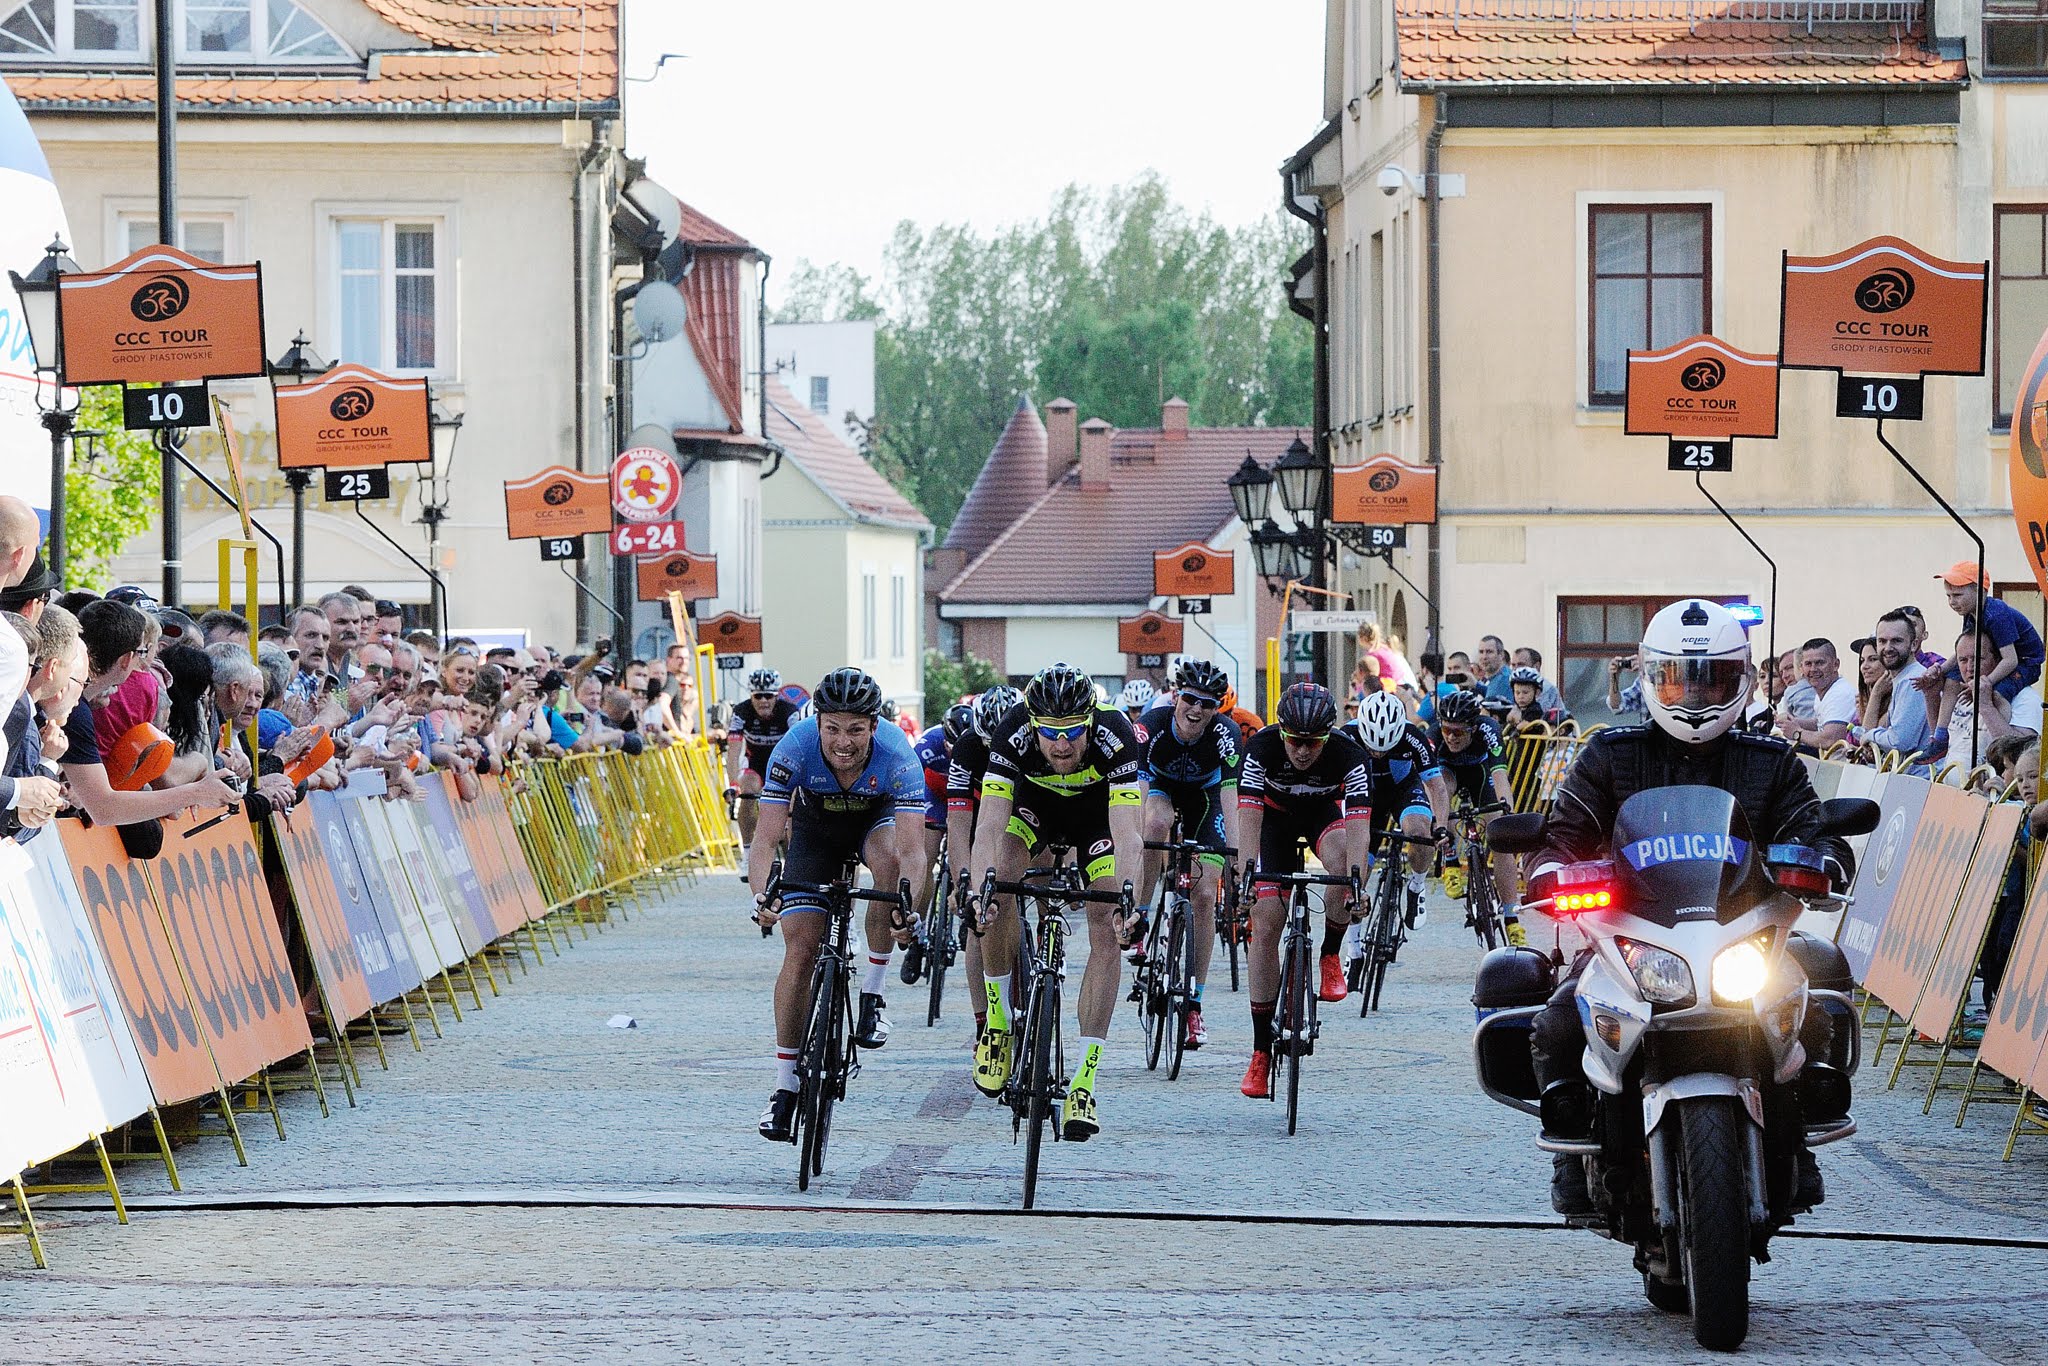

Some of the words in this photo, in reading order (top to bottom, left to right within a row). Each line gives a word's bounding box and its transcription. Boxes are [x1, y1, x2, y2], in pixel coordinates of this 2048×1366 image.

[114, 332, 150, 346] CCC
[160, 329, 208, 345] TOUR
[1836, 321, 1872, 335] CCC
[1881, 323, 1929, 338] TOUR
[112, 353, 146, 365] GRODY
[150, 350, 213, 363] PIASTOWSKIE
[1831, 343, 1866, 353] GRODY
[1869, 344, 1932, 356] PIASTOWSKIE
[1667, 397, 1694, 409] CCC
[1701, 398, 1737, 410] TOUR
[1863, 385, 1898, 412] 10
[148, 393, 183, 421] 10
[318, 428, 345, 440] CCC
[352, 426, 389, 439] TOUR
[1684, 446, 1714, 467] 25
[340, 474, 371, 497] 25
[1359, 497, 1378, 505] CCC
[1382, 496, 1408, 505] TOUR
[536, 509, 555, 519] CCC
[559, 508, 584, 517] TOUR
[617, 525, 677, 552] 6-24
[1373, 530, 1394, 545] 50
[551, 540, 572, 556] 50
[1186, 601, 1203, 612] 75
[1681, 637, 1711, 645] NOLAN
[1141, 655, 1161, 667] 100
[1406, 733, 1430, 766] WIBATECH
[947, 759, 972, 790] ROSE
[1240, 753, 1266, 791] ROSE
[1344, 764, 1369, 798] ROSE
[1638, 834, 1738, 868] POLICJA
[1675, 906, 1716, 915] HONDA
